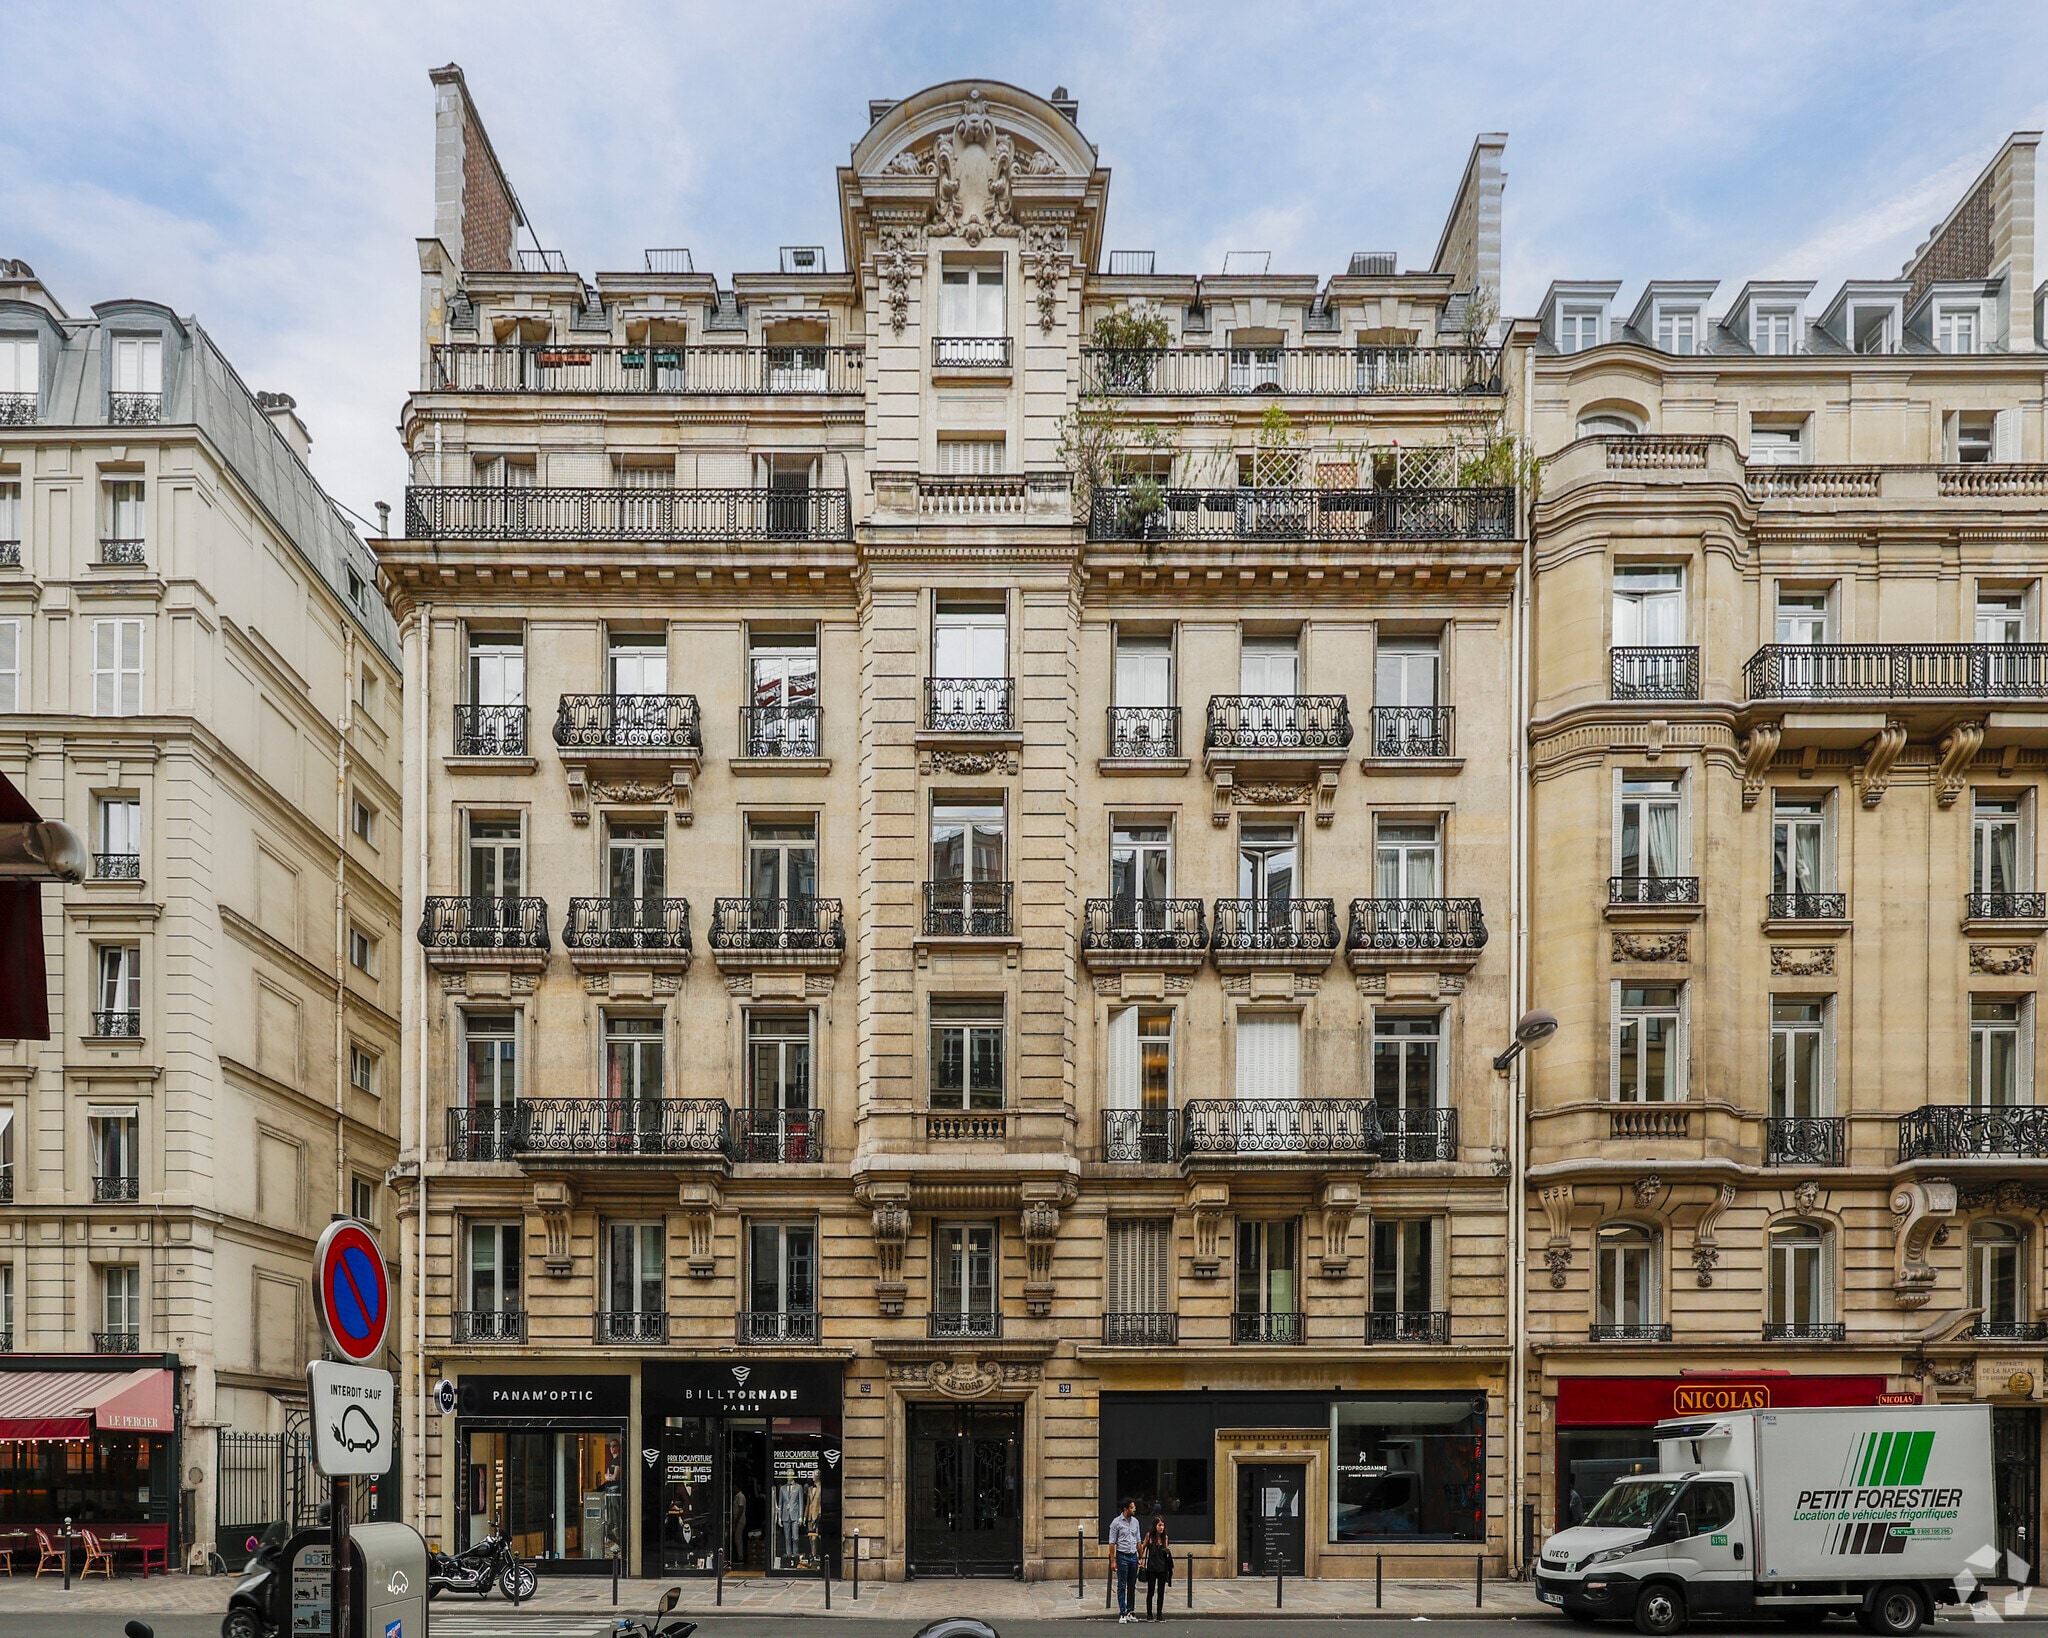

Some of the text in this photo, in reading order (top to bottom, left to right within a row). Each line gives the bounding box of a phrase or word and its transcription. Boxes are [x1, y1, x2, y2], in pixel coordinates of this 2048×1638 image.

[945, 1378, 957, 1389] LE
[959, 1379, 984, 1391] NORD
[1060, 1384, 1071, 1393] 32
[330, 1383, 382, 1400] INTERDIT SAUF
[492, 1390, 594, 1401] PANAM'OPTIC
[685, 1389, 798, 1400] BILLTORNADE
[1680, 1391, 1764, 1409] NICOLAS
[1881, 1396, 1913, 1404] NICOLAS
[109, 1415, 158, 1428] LE PERCIER
[1796, 1489, 1963, 1509] PETIT FORESTIER
[1794, 1509, 1958, 1521] Location de véhicules frigorifiques
[1549, 1550, 1569, 1559] IVECO
